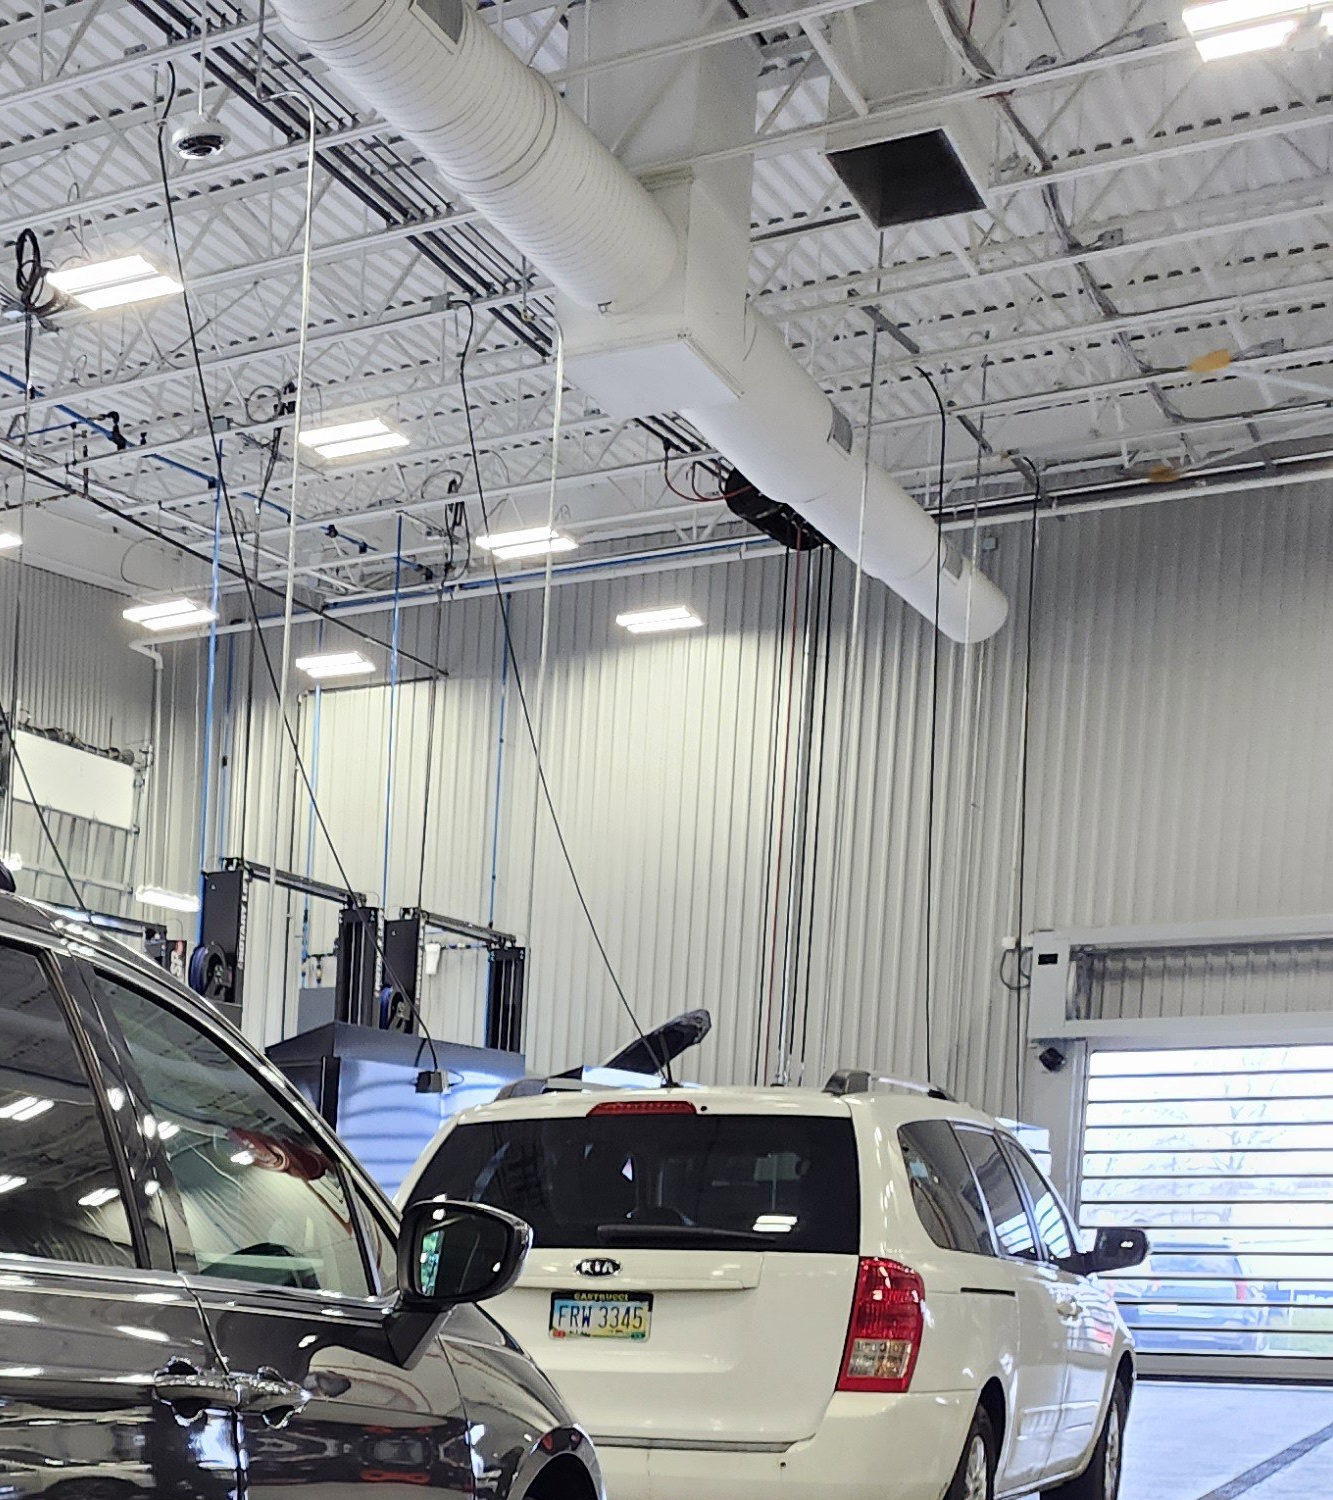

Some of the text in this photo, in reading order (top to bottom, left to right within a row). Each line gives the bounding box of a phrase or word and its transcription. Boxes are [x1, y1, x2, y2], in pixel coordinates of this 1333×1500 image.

[581, 1261, 614, 1274] KIA
[558, 1305, 644, 1330] FRW 3345
